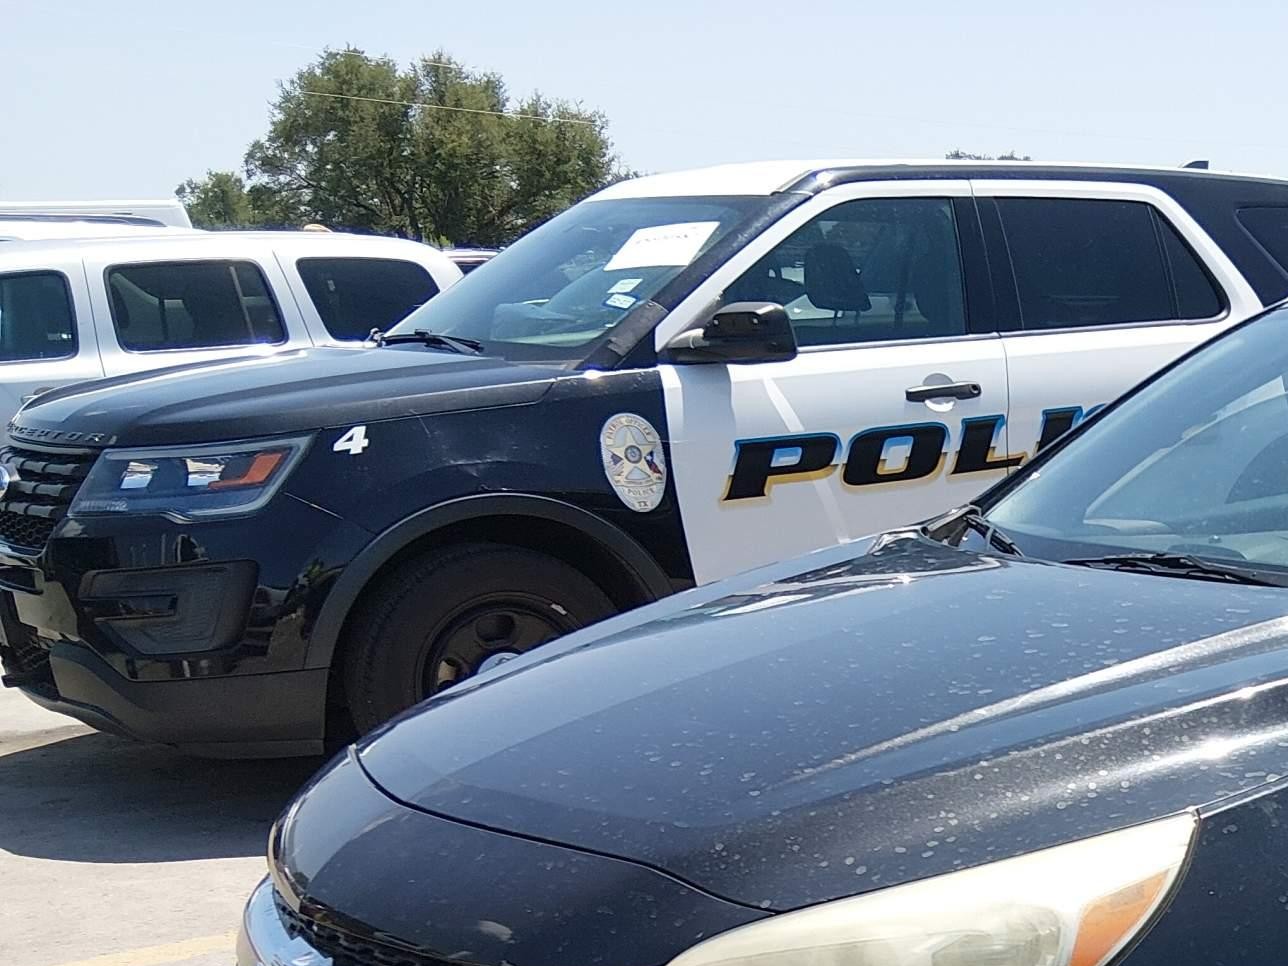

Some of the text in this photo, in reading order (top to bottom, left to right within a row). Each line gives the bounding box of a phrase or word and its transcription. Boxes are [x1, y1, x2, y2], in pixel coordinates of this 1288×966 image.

[333, 425, 369, 455] 4
[721, 404, 1106, 502] POLI
[637, 500, 649, 508] TX
